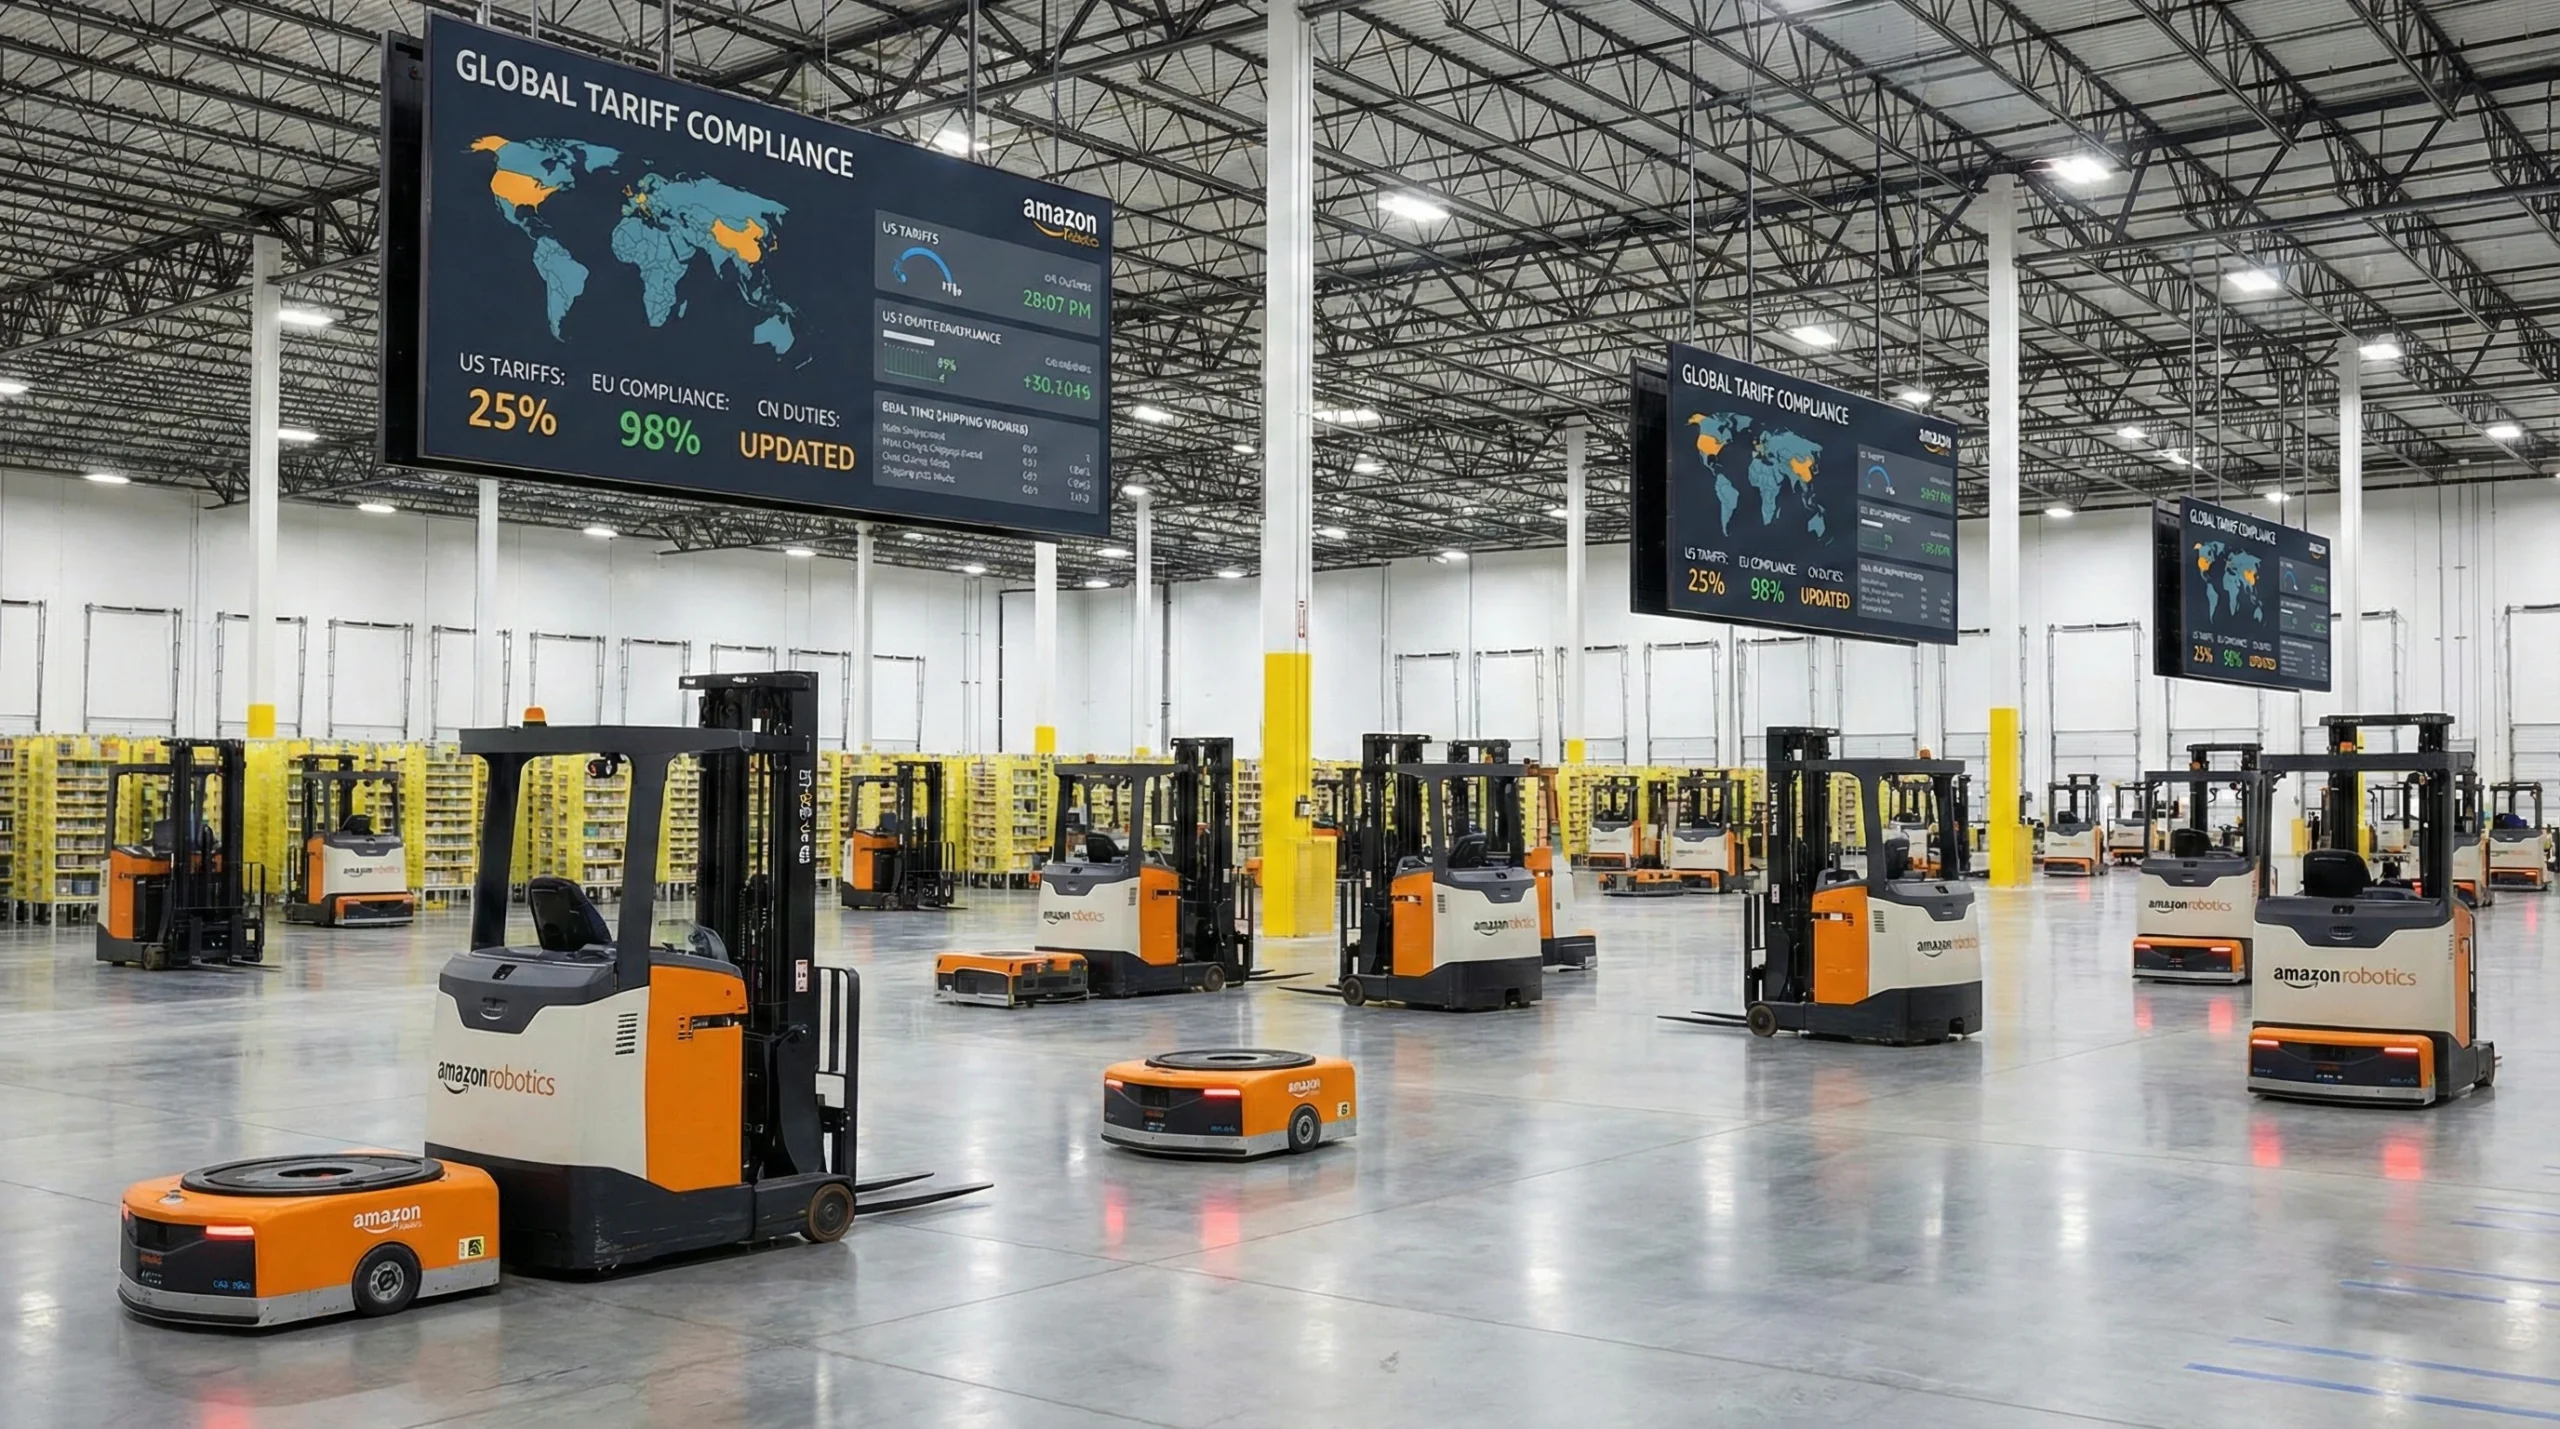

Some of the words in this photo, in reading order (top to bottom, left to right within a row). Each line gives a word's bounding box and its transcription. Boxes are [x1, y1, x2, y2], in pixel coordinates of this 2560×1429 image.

[455, 48, 577, 108] GLOBAL
[584, 80, 680, 131] TARIFF
[686, 110, 855, 178] COMPLIANCE
[882, 221, 898, 235] US
[1023, 197, 1097, 234] amazon
[1023, 289, 1065, 313] 28:07
[1069, 299, 1092, 320] PM
[460, 352, 485, 374] US
[490, 357, 567, 386] TARIFFS:
[592, 373, 615, 394] EU
[619, 378, 730, 411] COMPLIANCE:
[1682, 363, 1733, 394] GLOBAL
[1734, 377, 1775, 405] TARIFF
[1777, 389, 1849, 425] COMPLIANCE
[467, 387, 558, 437] 25%
[757, 399, 780, 420] CN
[784, 403, 840, 428] DUTIES:
[619, 410, 701, 455] 98%
[740, 430, 855, 471] UPDATED
[1688, 567, 1725, 595] 25%
[1751, 577, 1785, 603] 98%
[1800, 586, 1850, 609] UPDATED
[353, 1205, 421, 1228] amazon
